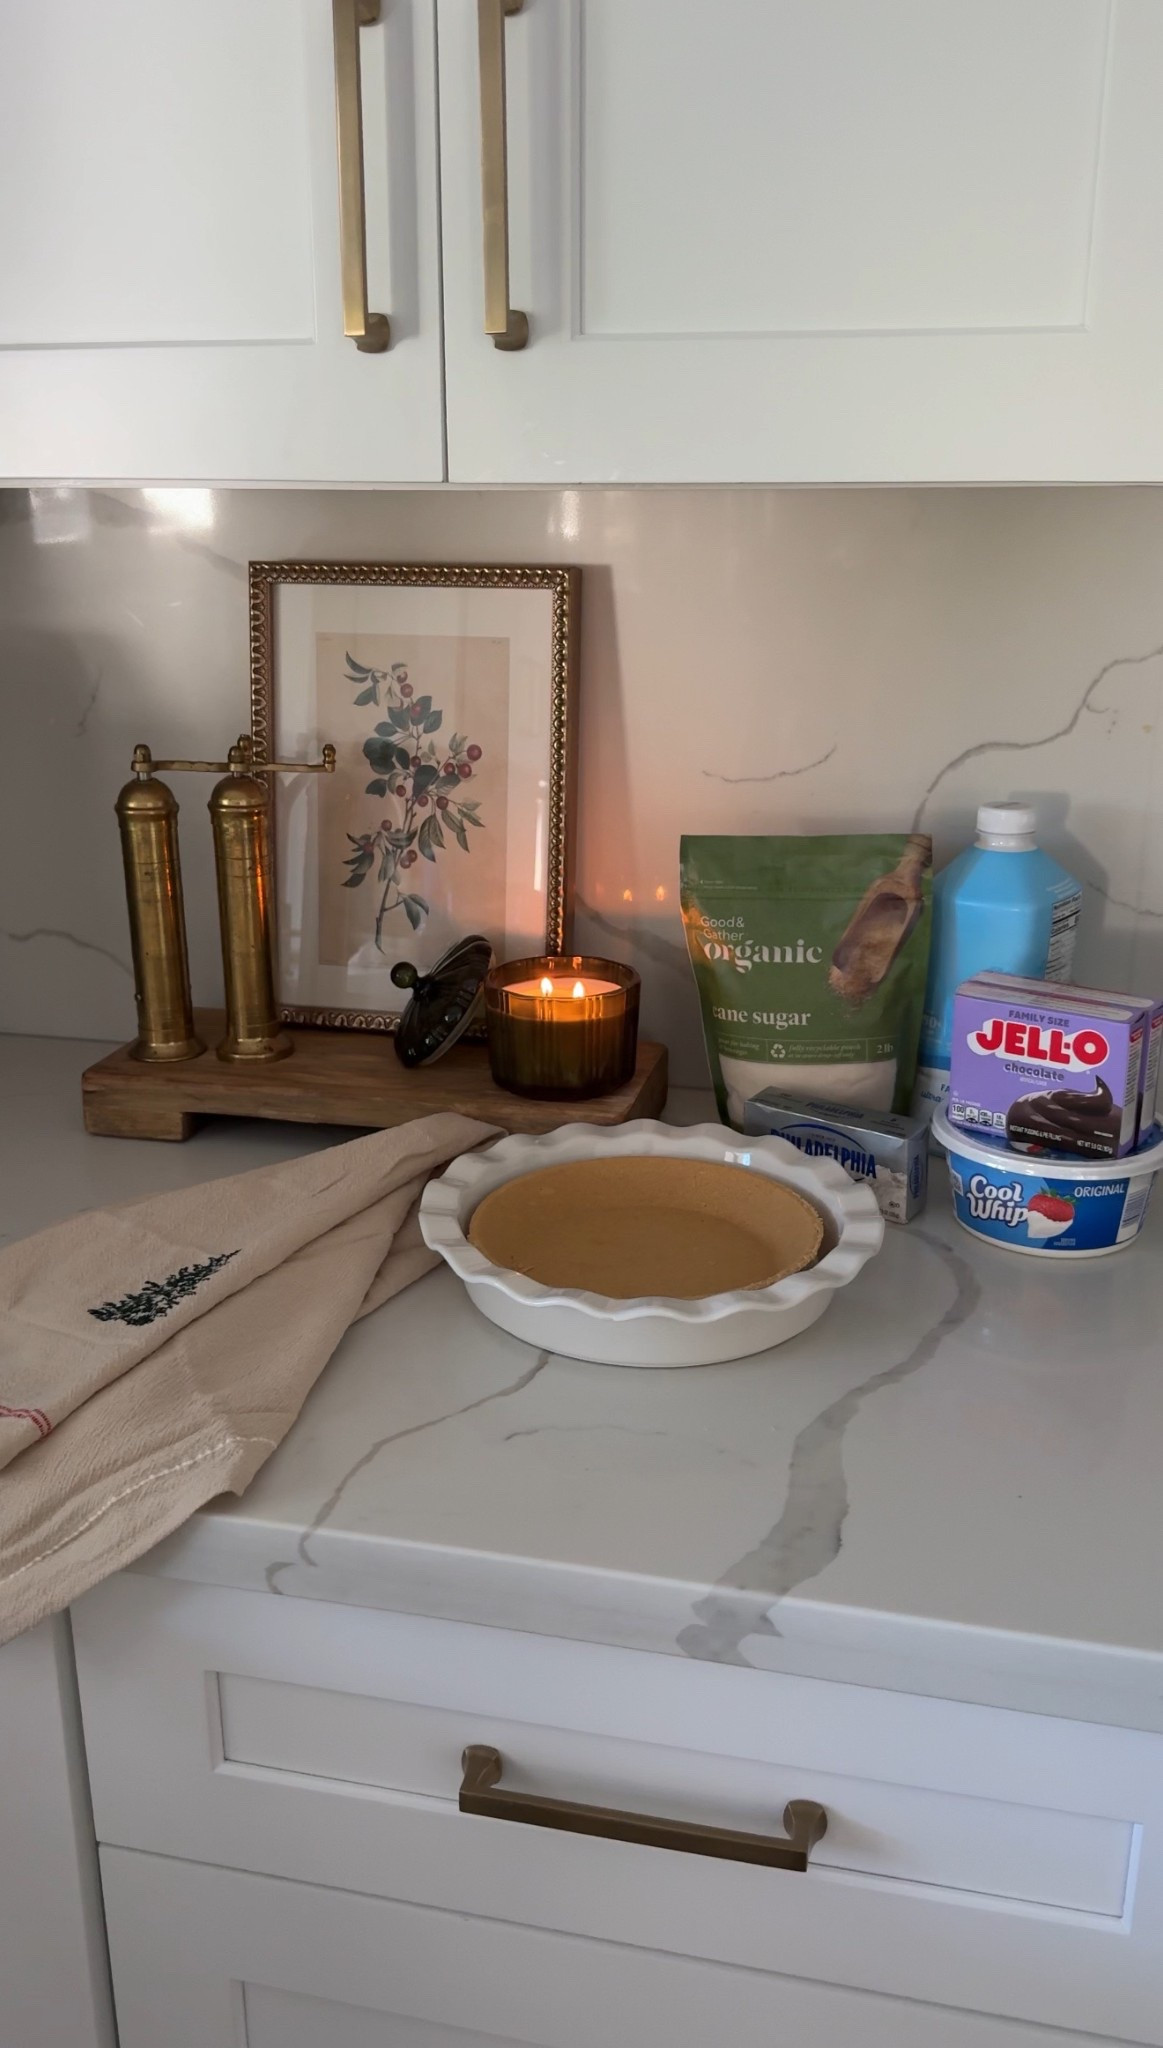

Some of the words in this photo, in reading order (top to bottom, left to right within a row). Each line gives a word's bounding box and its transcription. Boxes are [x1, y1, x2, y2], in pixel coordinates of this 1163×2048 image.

[703, 929, 745, 941] Gather
[703, 939, 823, 974] organic
[752, 1011, 812, 1031] sugar
[1008, 1009, 1046, 1024] FAMILY
[1047, 1015, 1070, 1028] SIZE
[876, 1044, 883, 1054] 2
[975, 1019, 1109, 1066] JELL-O
[1004, 1062, 1065, 1082] chocolate
[770, 1128, 877, 1179] LADELPHIA
[969, 1174, 1023, 1202] Cool
[1074, 1183, 1125, 1198] ORIGINAL
[966, 1192, 1029, 1227] Whip
